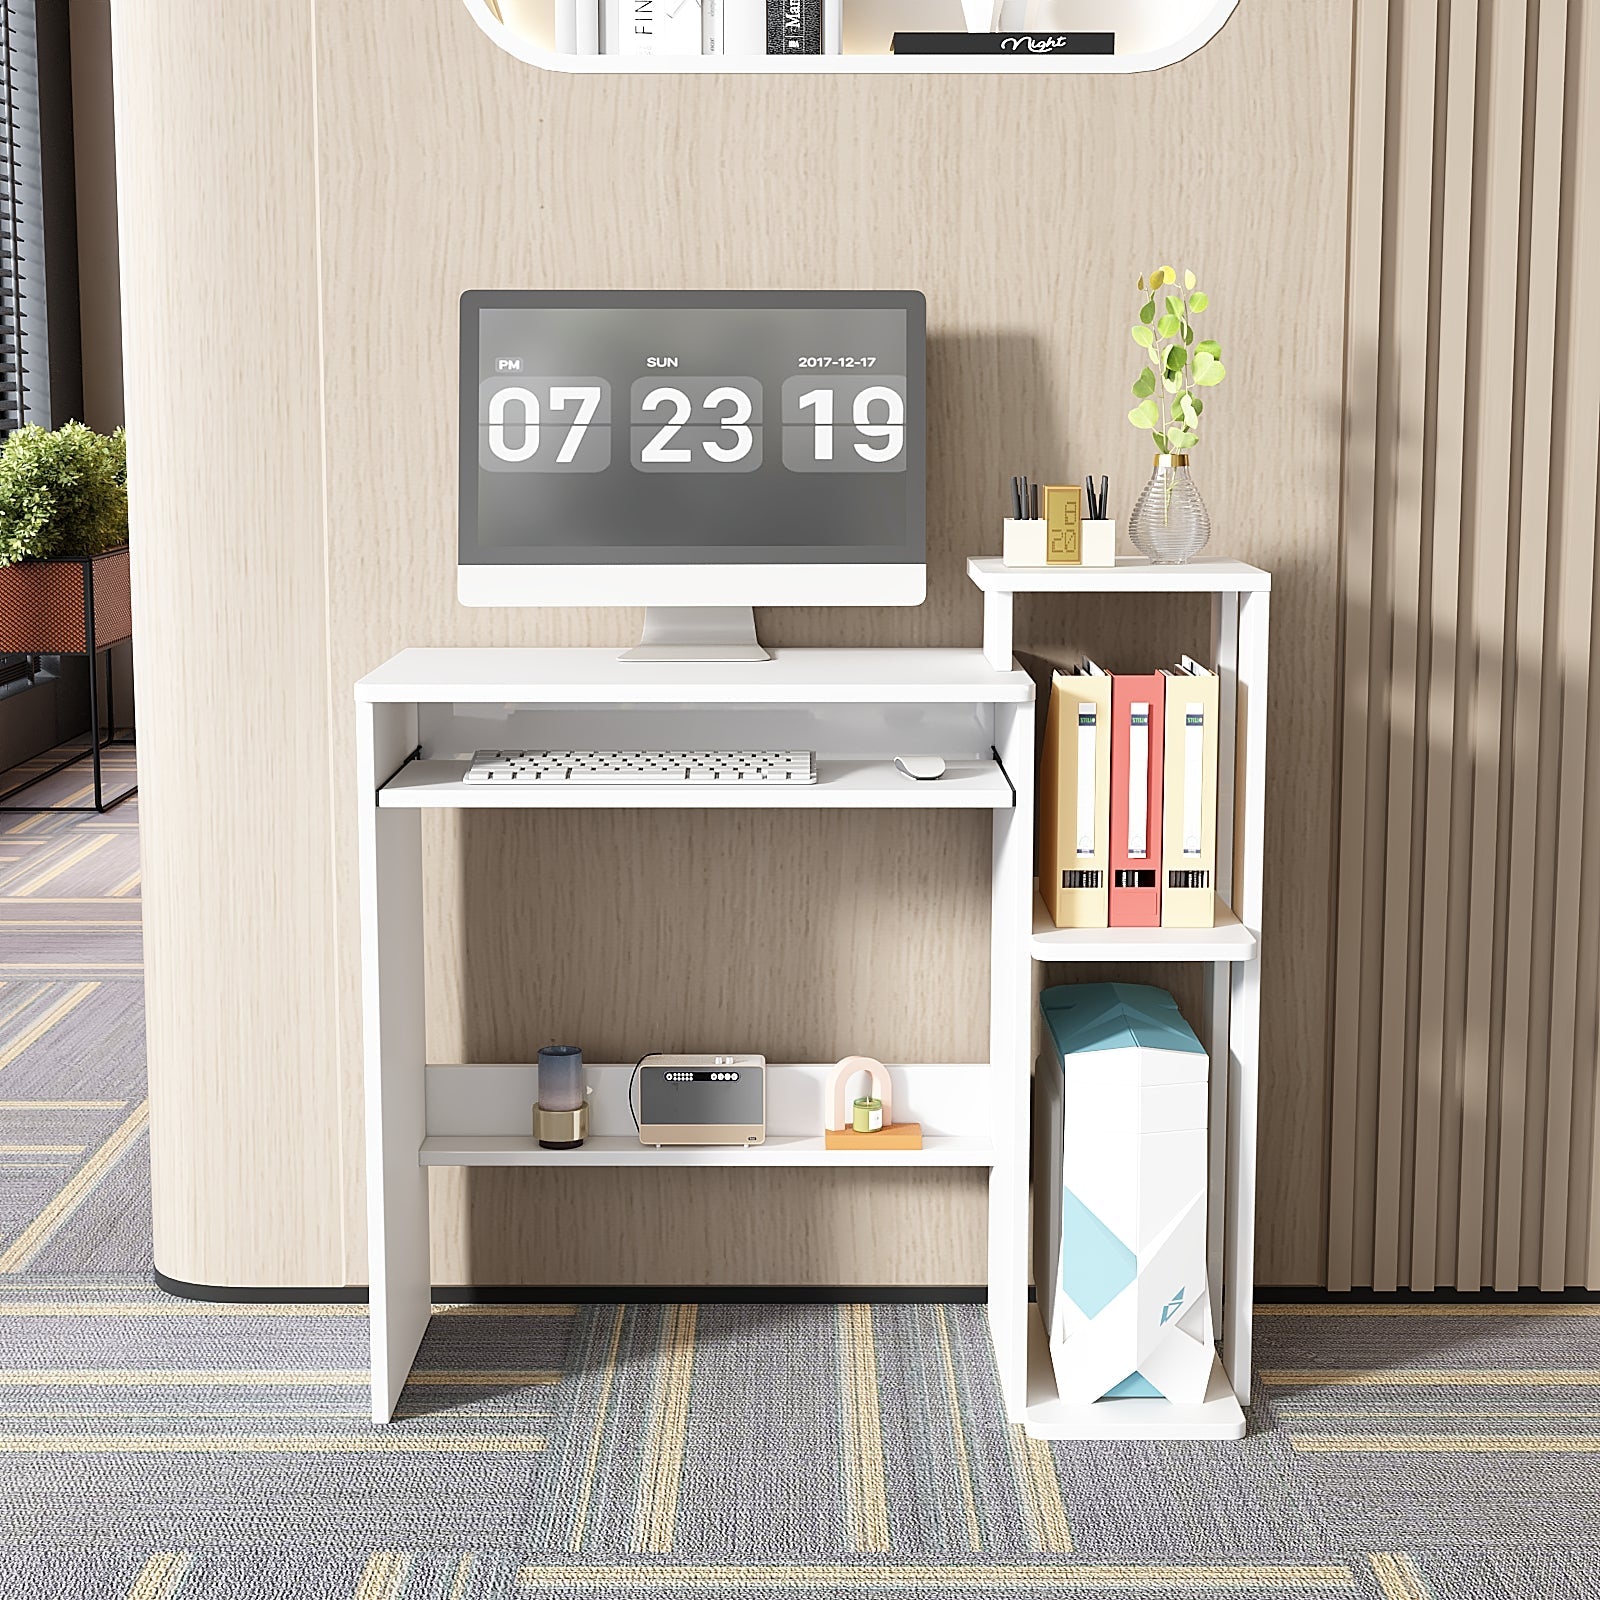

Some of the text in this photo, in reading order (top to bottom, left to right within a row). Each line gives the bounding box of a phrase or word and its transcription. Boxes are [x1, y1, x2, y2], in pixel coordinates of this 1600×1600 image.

[1000, 36, 1067, 53] Night
[498, 359, 521, 371] PM
[646, 356, 679, 368] SUN
[798, 356, 877, 368] 2017-12-17
[489, 386, 904, 463] 07 23 19
